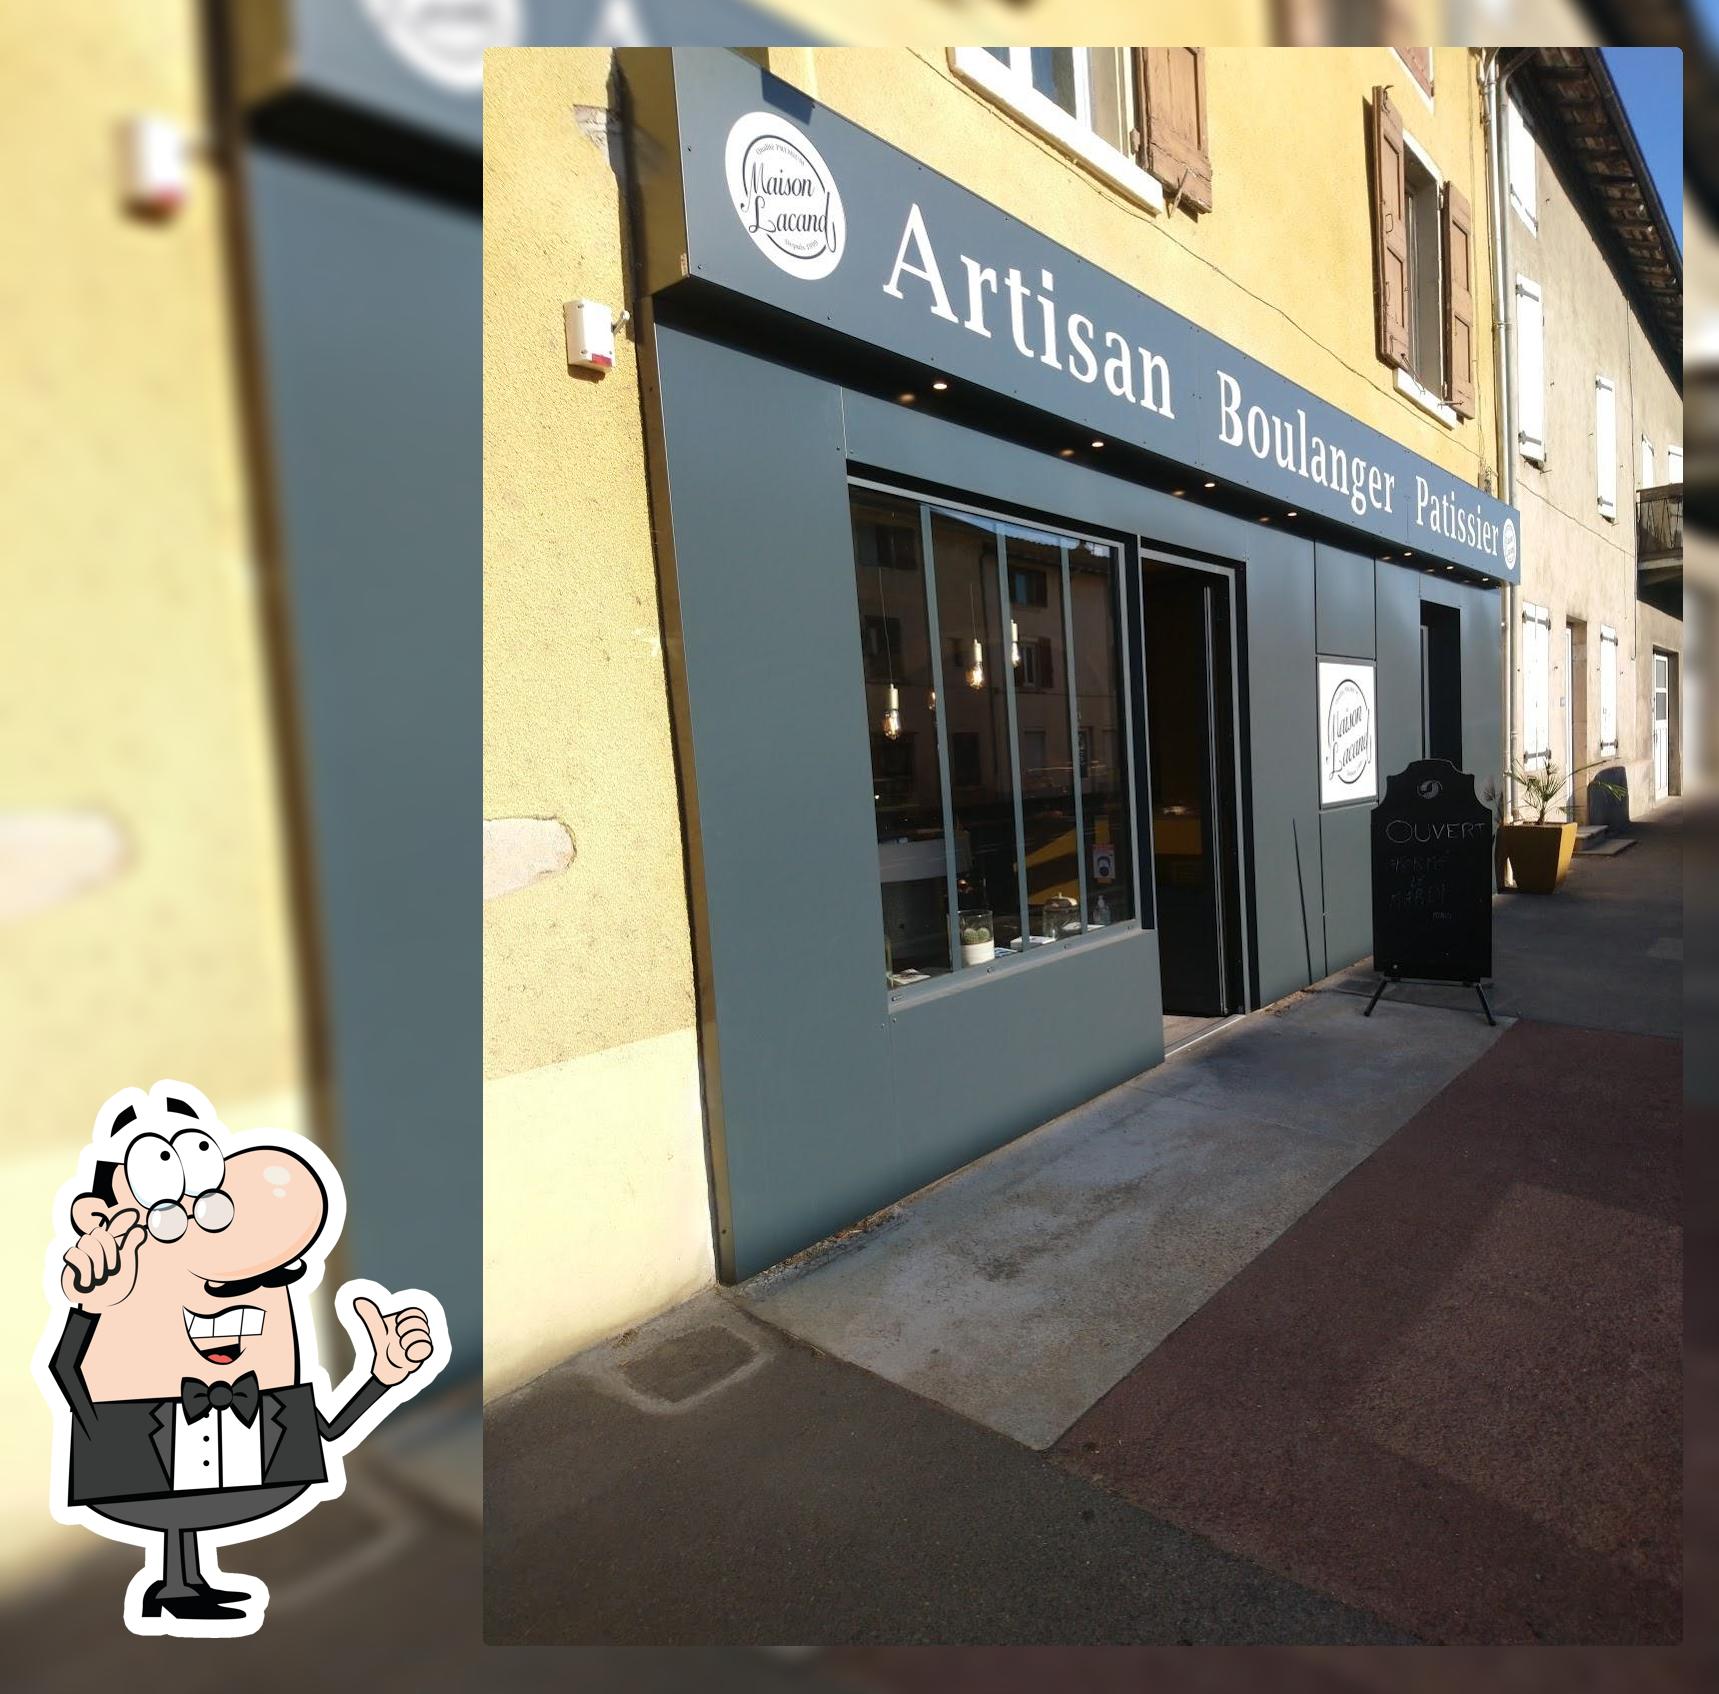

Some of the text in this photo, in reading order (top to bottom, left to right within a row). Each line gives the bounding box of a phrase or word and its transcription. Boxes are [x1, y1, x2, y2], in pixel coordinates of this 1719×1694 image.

[740, 162, 814, 212] Maison
[882, 202, 1500, 557] Artisan Boulanger Patissier
[1385, 819, 1486, 843] OUVERT
